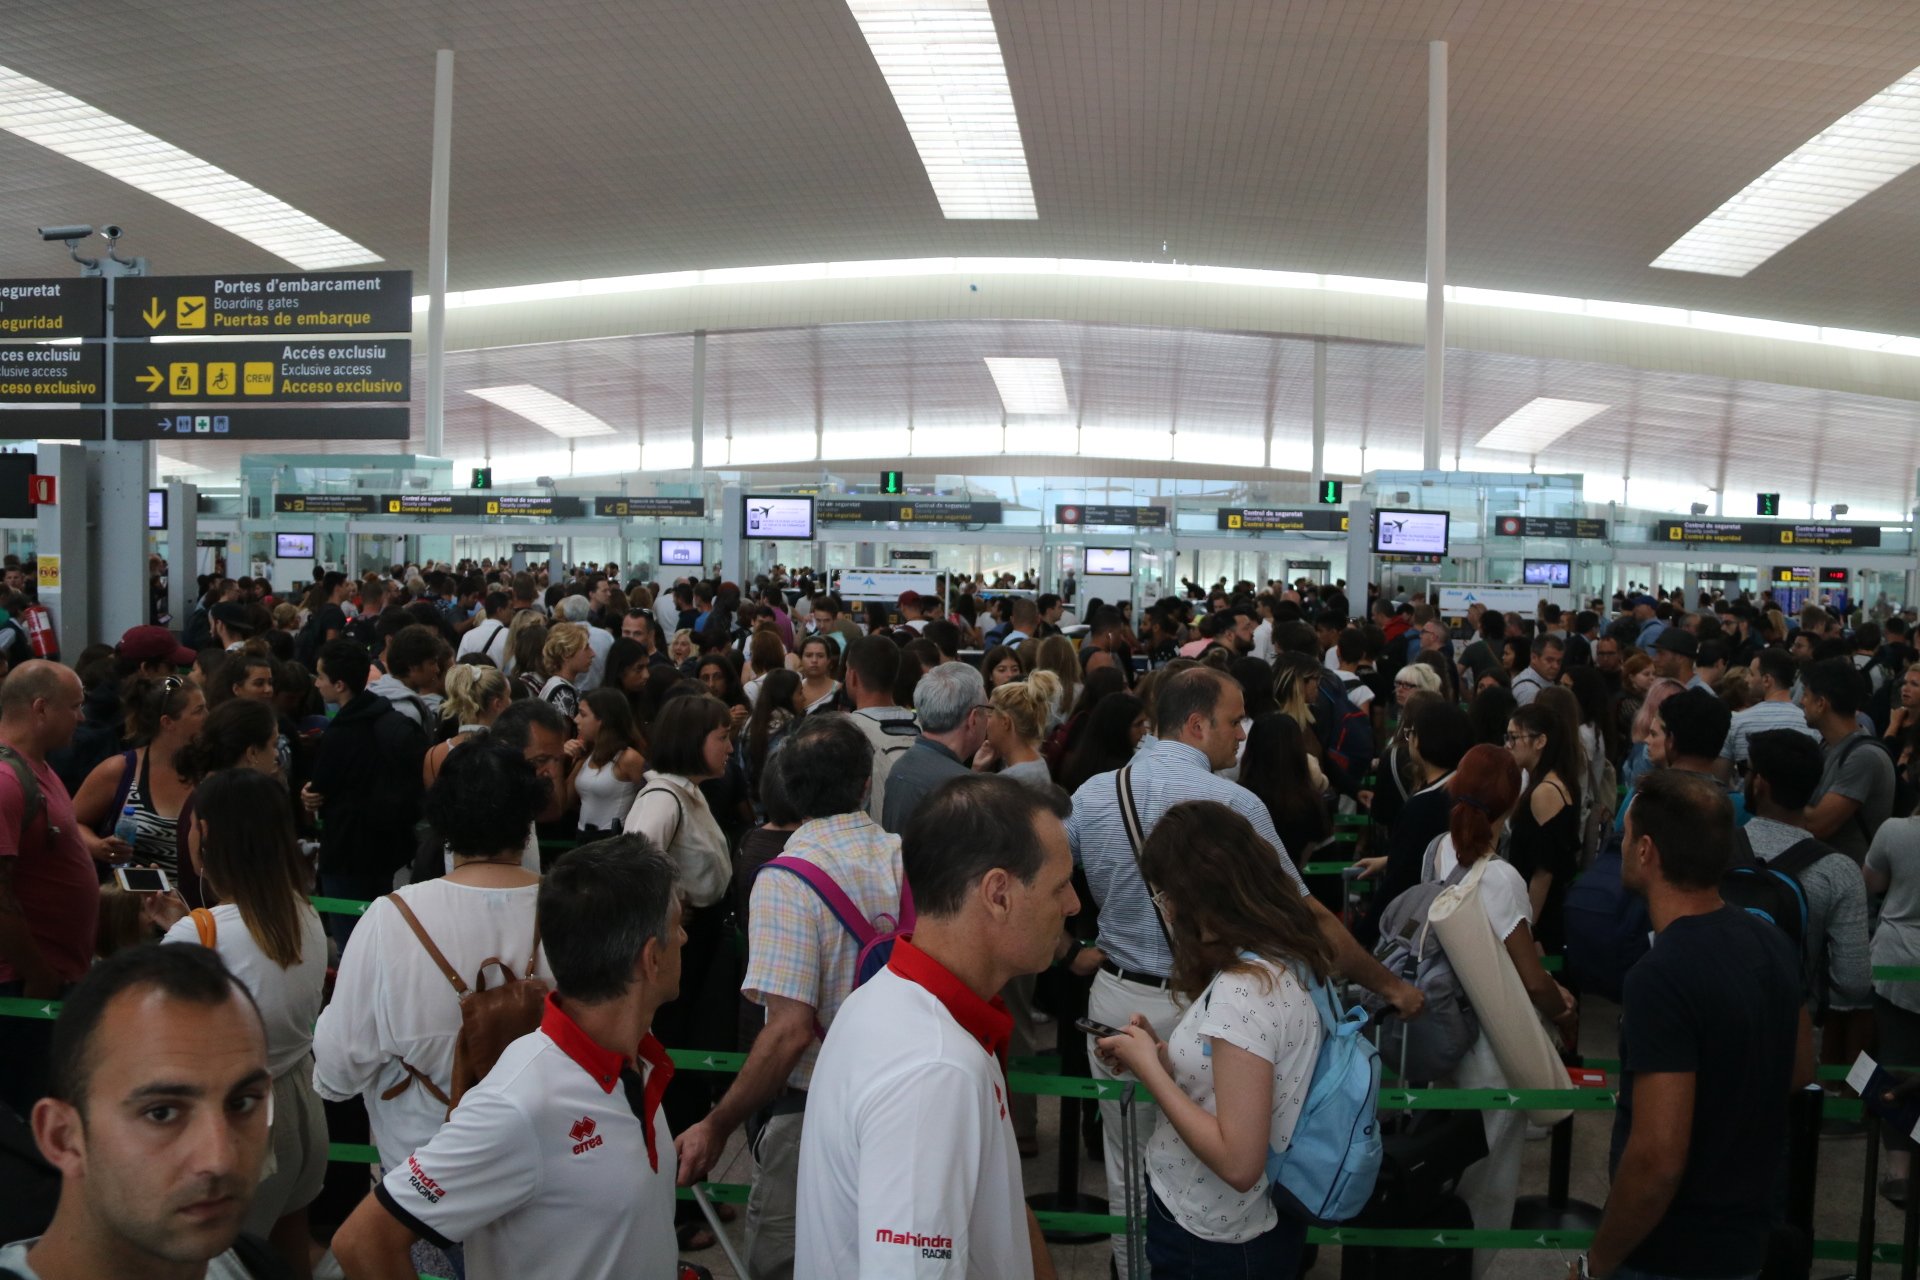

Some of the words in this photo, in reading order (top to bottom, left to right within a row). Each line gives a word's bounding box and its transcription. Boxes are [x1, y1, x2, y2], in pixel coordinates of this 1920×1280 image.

[214, 279, 261, 294] Portes
[266, 277, 381, 292] d'embarcament
[214, 296, 264, 311] Boarding
[267, 297, 299, 311] gates
[214, 312, 269, 327] Puertas
[274, 312, 292, 326] de
[297, 310, 371, 327] embarque
[0, 351, 24, 361] ces
[27, 348, 80, 361] exclusiu
[328, 345, 386, 359] exclusiu
[32, 367, 67, 377] access
[281, 363, 331, 376] Exclusive
[333, 365, 373, 375] access
[246, 373, 271, 383] CREW
[0, 383, 31, 394] ceso
[35, 380, 96, 394] exclusivo
[281, 379, 333, 393] Acceso
[336, 378, 402, 393] exclusivo
[573, 1135, 603, 1155] errea
[409, 1175, 440, 1204] RACING
[876, 1229, 952, 1248] Mahindra
[922, 1248, 952, 1259] RACING
